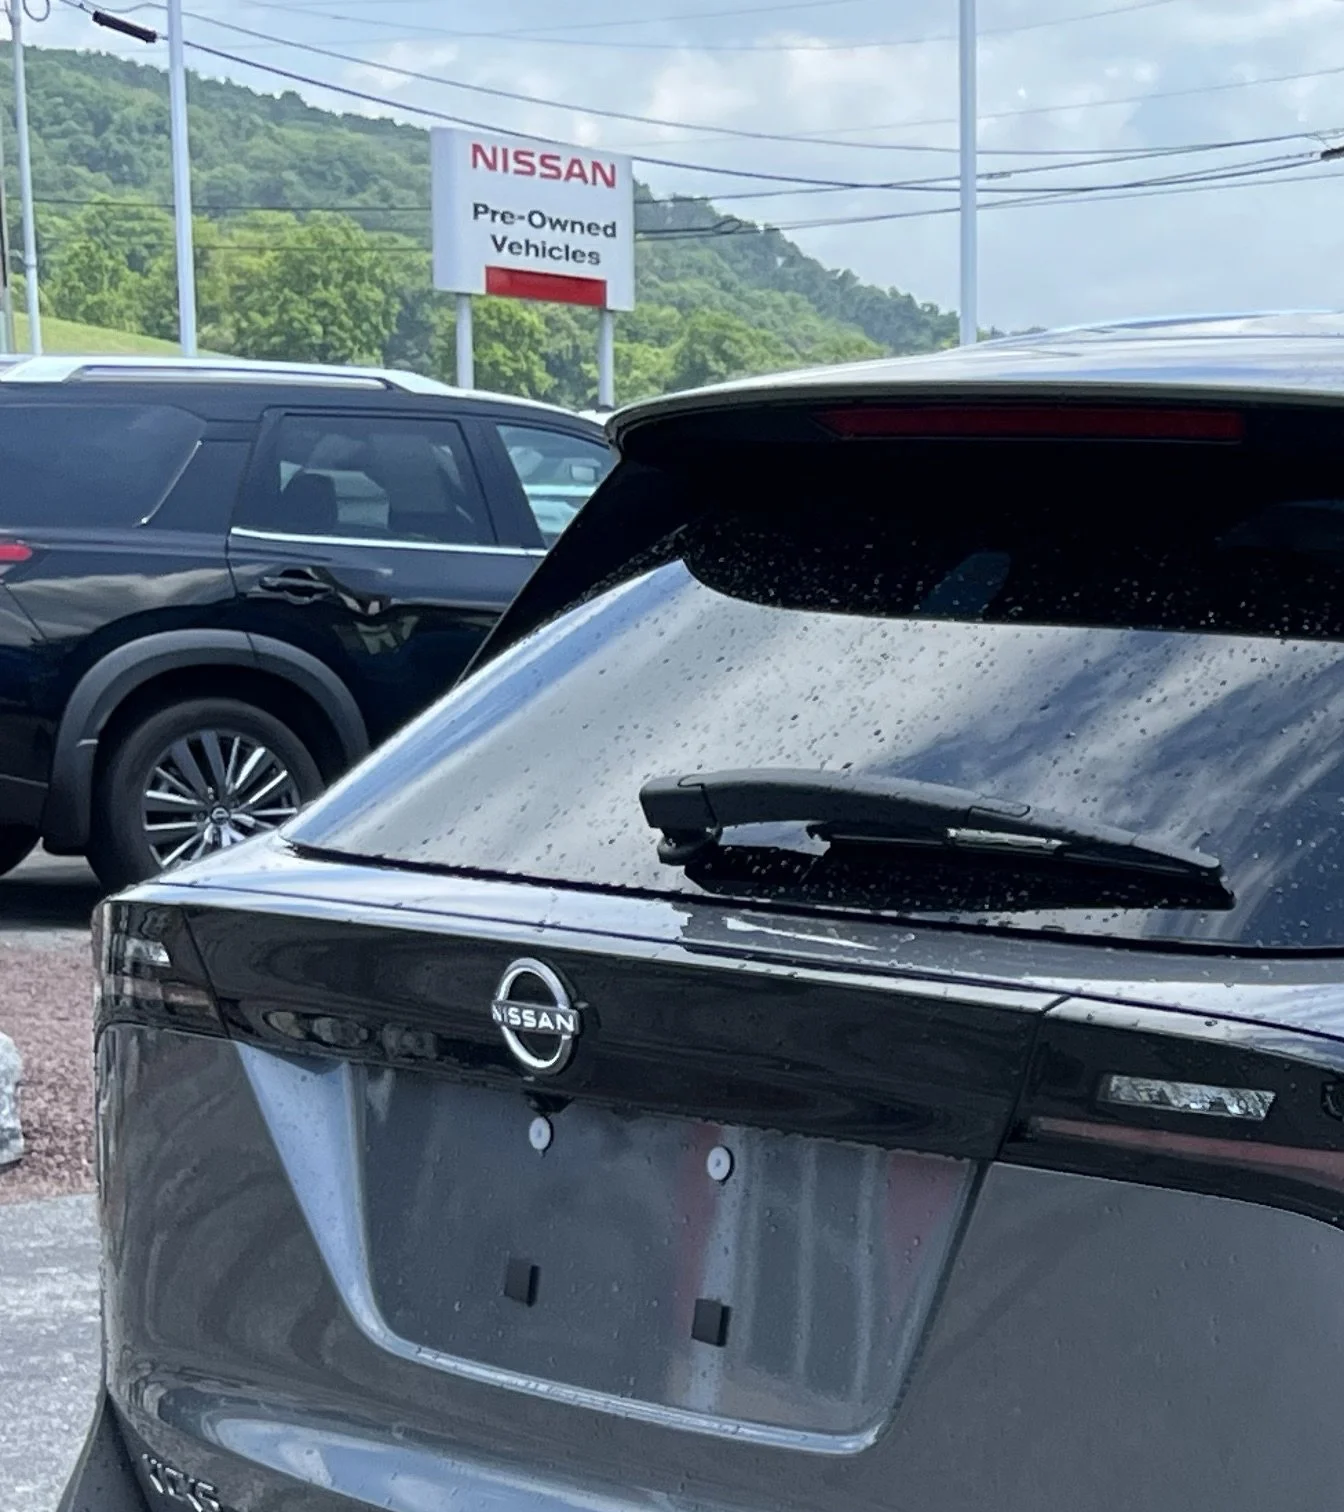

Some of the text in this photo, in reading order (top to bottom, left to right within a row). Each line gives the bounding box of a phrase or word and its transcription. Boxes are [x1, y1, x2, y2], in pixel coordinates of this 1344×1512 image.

[471, 143, 617, 190] NISSAN
[472, 202, 618, 239] Pre-Owned
[490, 234, 601, 266] Vehicles
[491, 1003, 575, 1032] NISSAN
